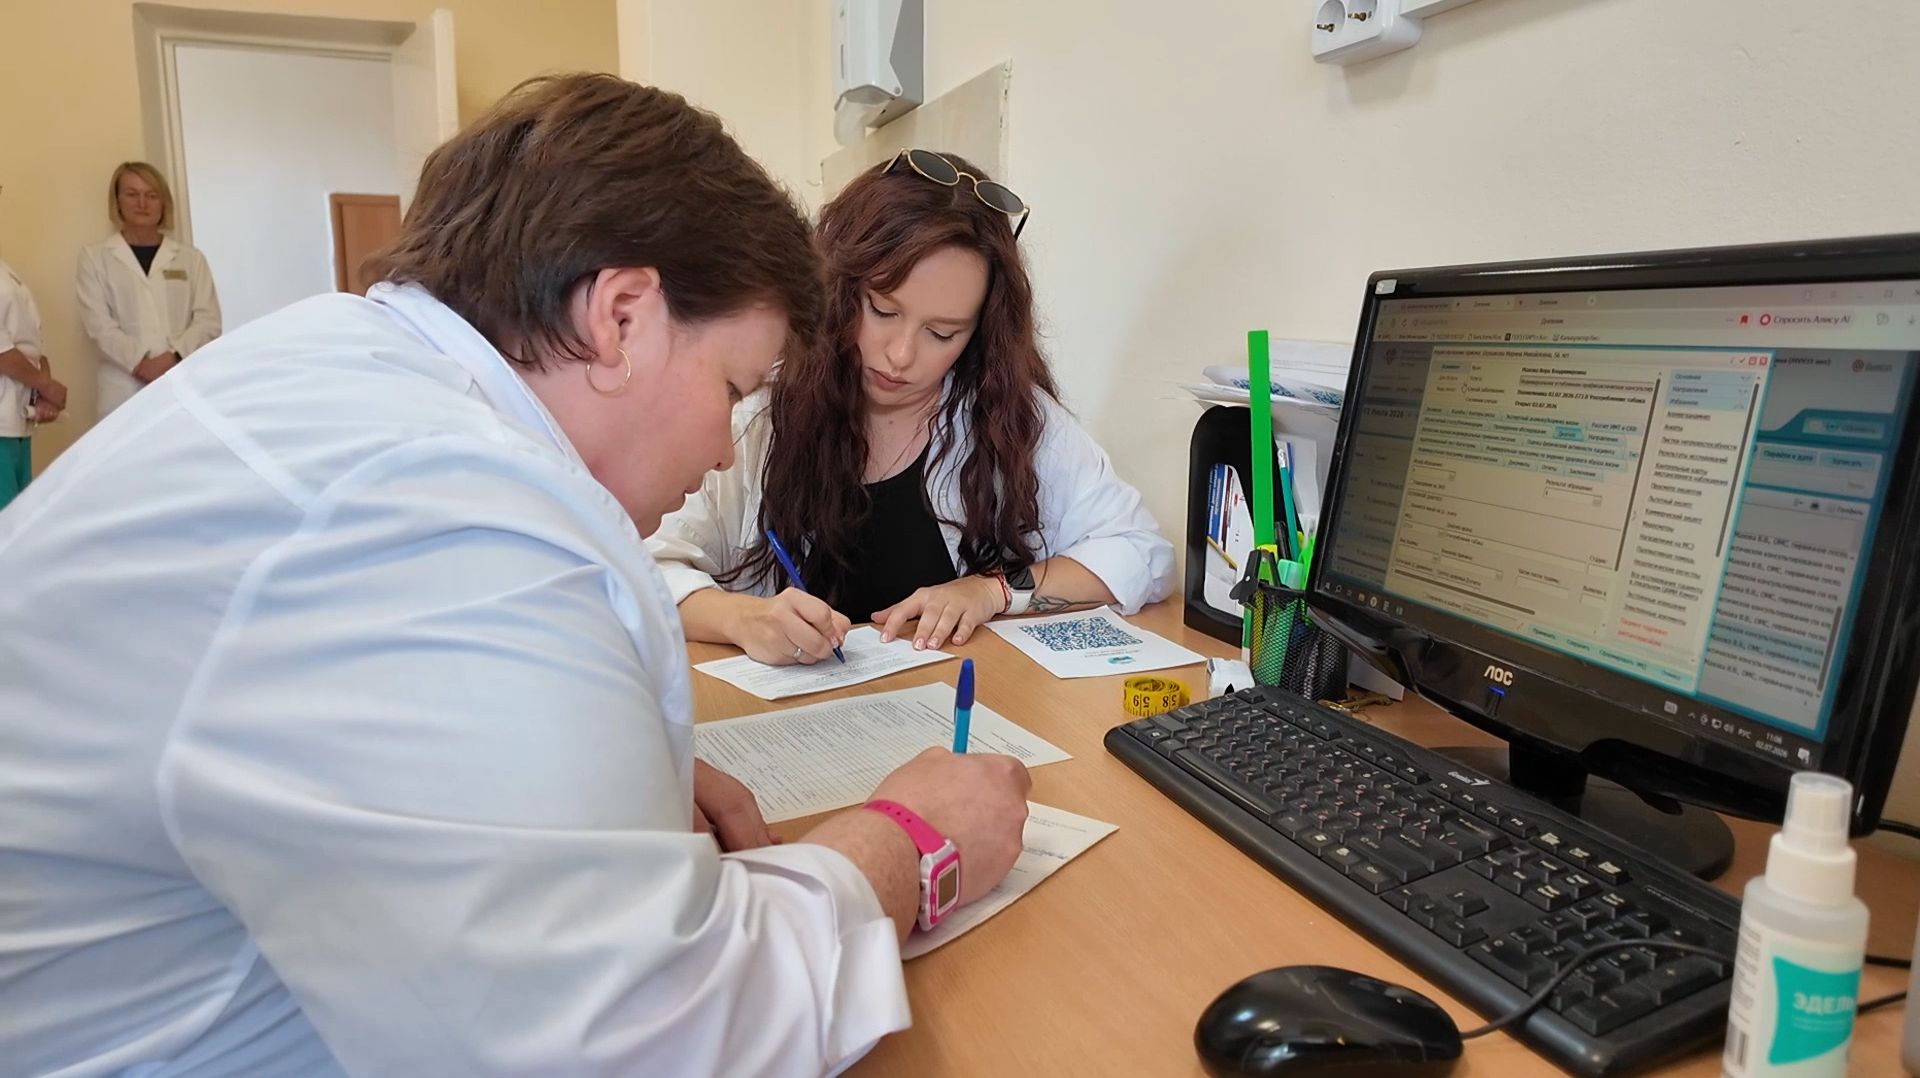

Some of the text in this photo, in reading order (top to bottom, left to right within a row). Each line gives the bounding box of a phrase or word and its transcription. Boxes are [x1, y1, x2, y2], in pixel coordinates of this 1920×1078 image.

[1774, 314, 1812, 325] Спросить
[1814, 315, 1839, 326] Алису
[1738, 728, 1753, 740] РУС
